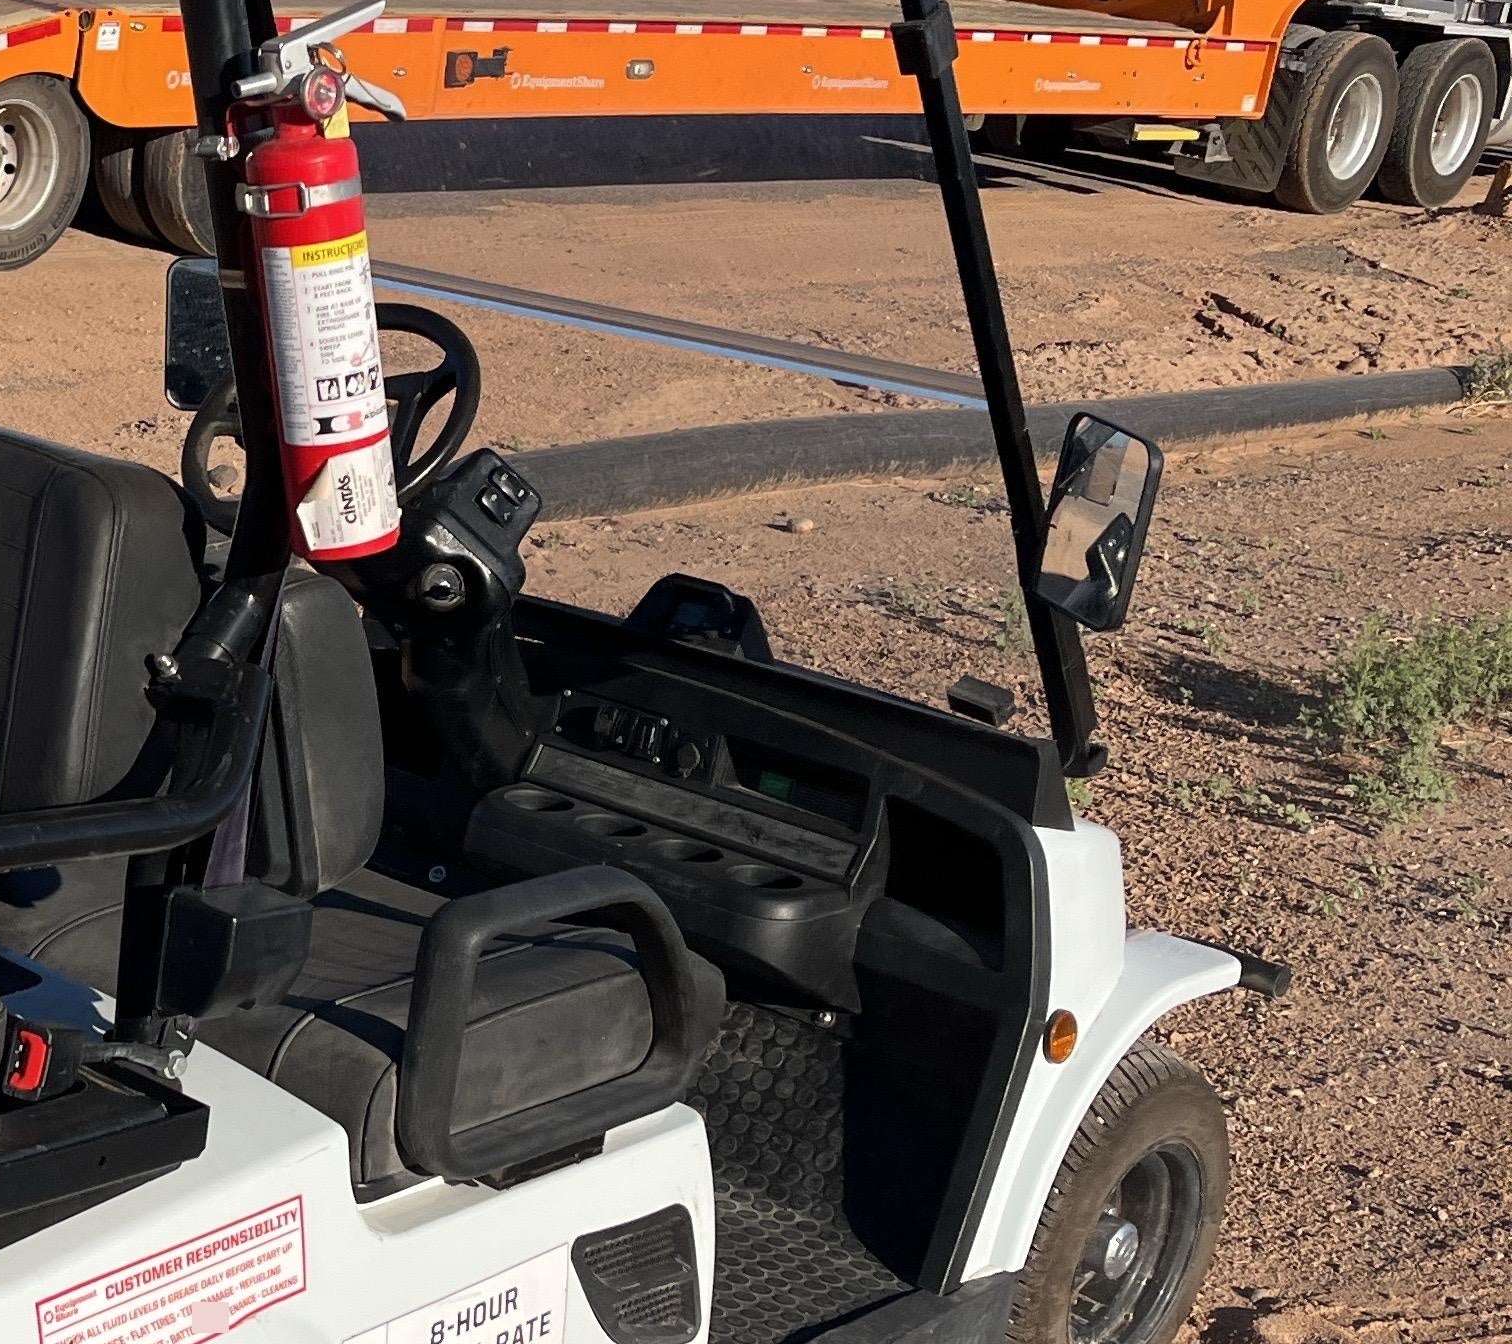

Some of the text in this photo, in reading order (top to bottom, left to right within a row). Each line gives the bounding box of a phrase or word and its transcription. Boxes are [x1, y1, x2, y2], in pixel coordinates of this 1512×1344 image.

[336, 473, 357, 524] CINTAS
[87, 1325, 102, 1339] ALL
[102, 1313, 128, 1332] FLUID
[128, 1300, 159, 1320] LEVELS
[168, 1282, 200, 1303] GREASE
[200, 1271, 225, 1289] DAILY
[225, 1259, 256, 1279] BEFORE
[256, 1246, 281, 1265] START
[282, 1242, 294, 1254] UP
[105, 1208, 298, 1300] CUSTOMER RESPONSIBILITY
[261, 1275, 299, 1299] CLEANING
[130, 1324, 151, 1341] FLAT
[150, 1313, 177, 1332] TIRES
[239, 1264, 282, 1291] REFUELING
